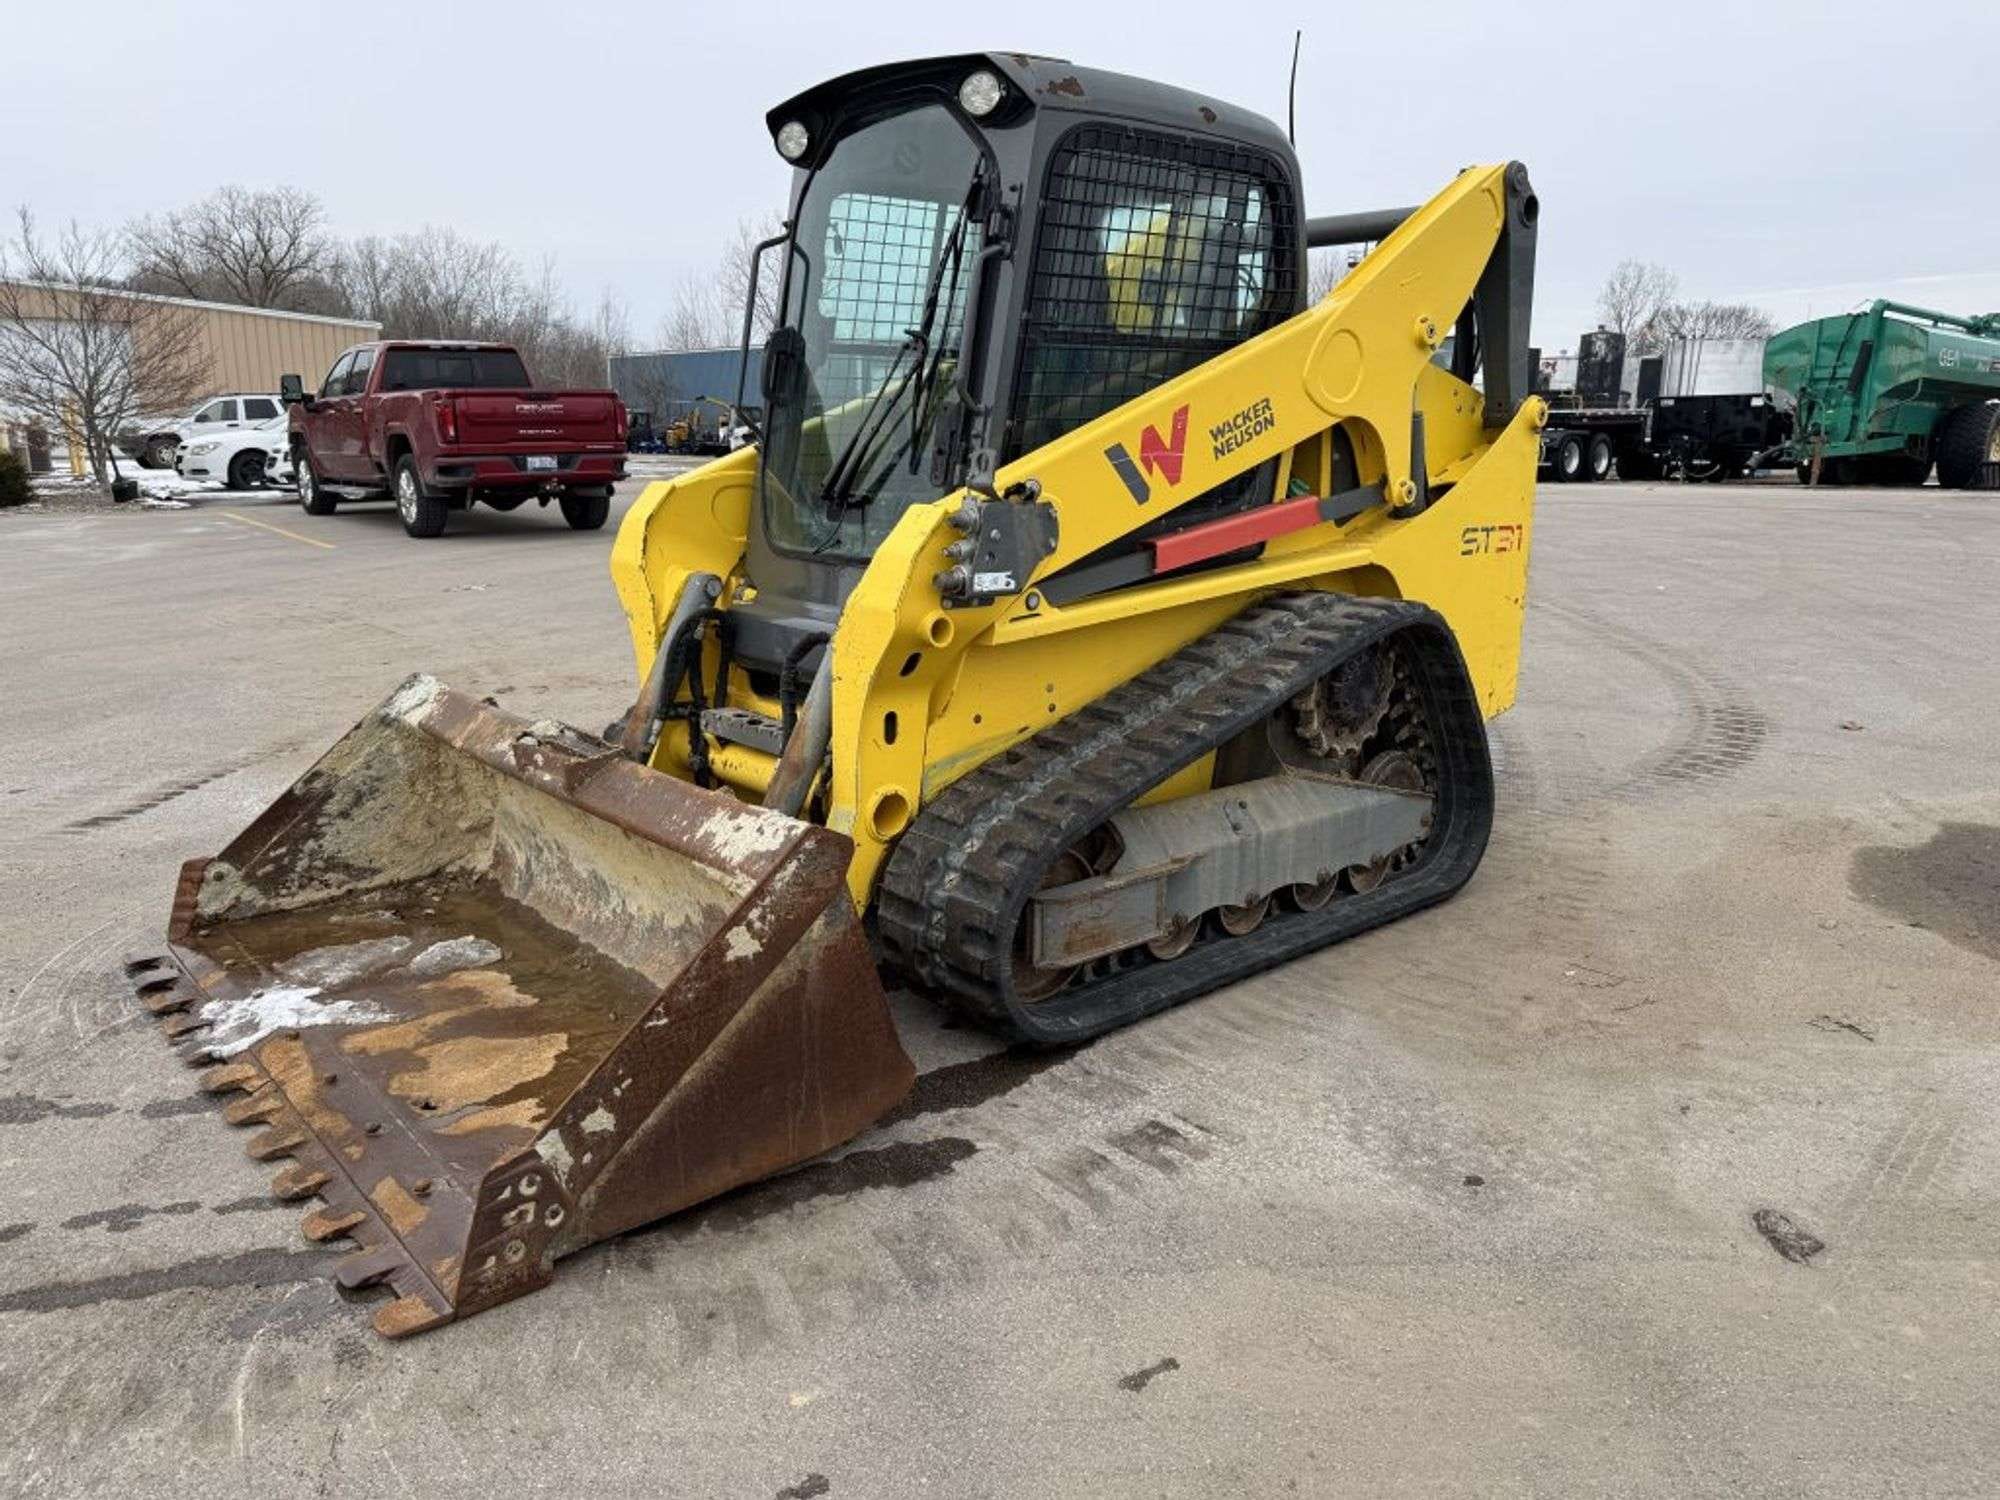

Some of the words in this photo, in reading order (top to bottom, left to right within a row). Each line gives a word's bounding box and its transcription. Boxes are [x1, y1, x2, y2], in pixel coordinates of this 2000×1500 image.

[1209, 397, 1272, 442] WACKER
[1213, 412, 1275, 460] NEUSON
[1460, 524, 1523, 556] ST31
